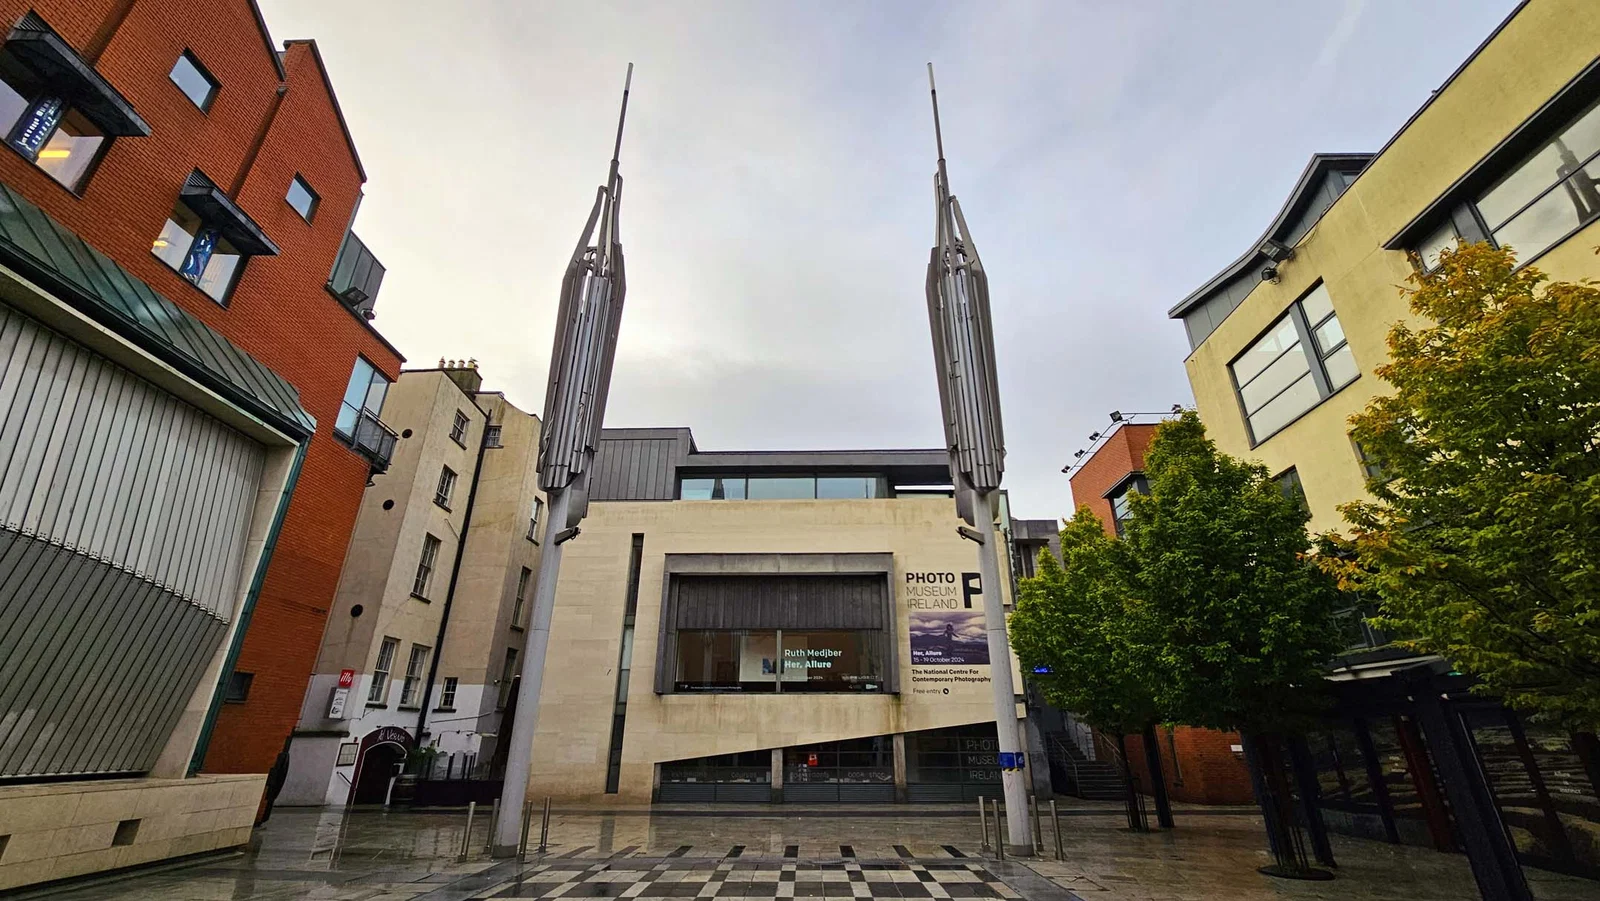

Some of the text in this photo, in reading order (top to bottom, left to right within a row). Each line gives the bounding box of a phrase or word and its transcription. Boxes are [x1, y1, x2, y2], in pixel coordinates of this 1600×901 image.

[906, 572, 955, 584] PHOTO
[906, 586, 957, 597] MUSEUM
[907, 598, 958, 610] IRELAND
[784, 649, 842, 658] Ruth Medjber
[805, 660, 832, 668] Allure
[966, 739, 999, 750] PHOT
[968, 755, 999, 765] MUSEU
[970, 770, 1001, 780] IRELAN
